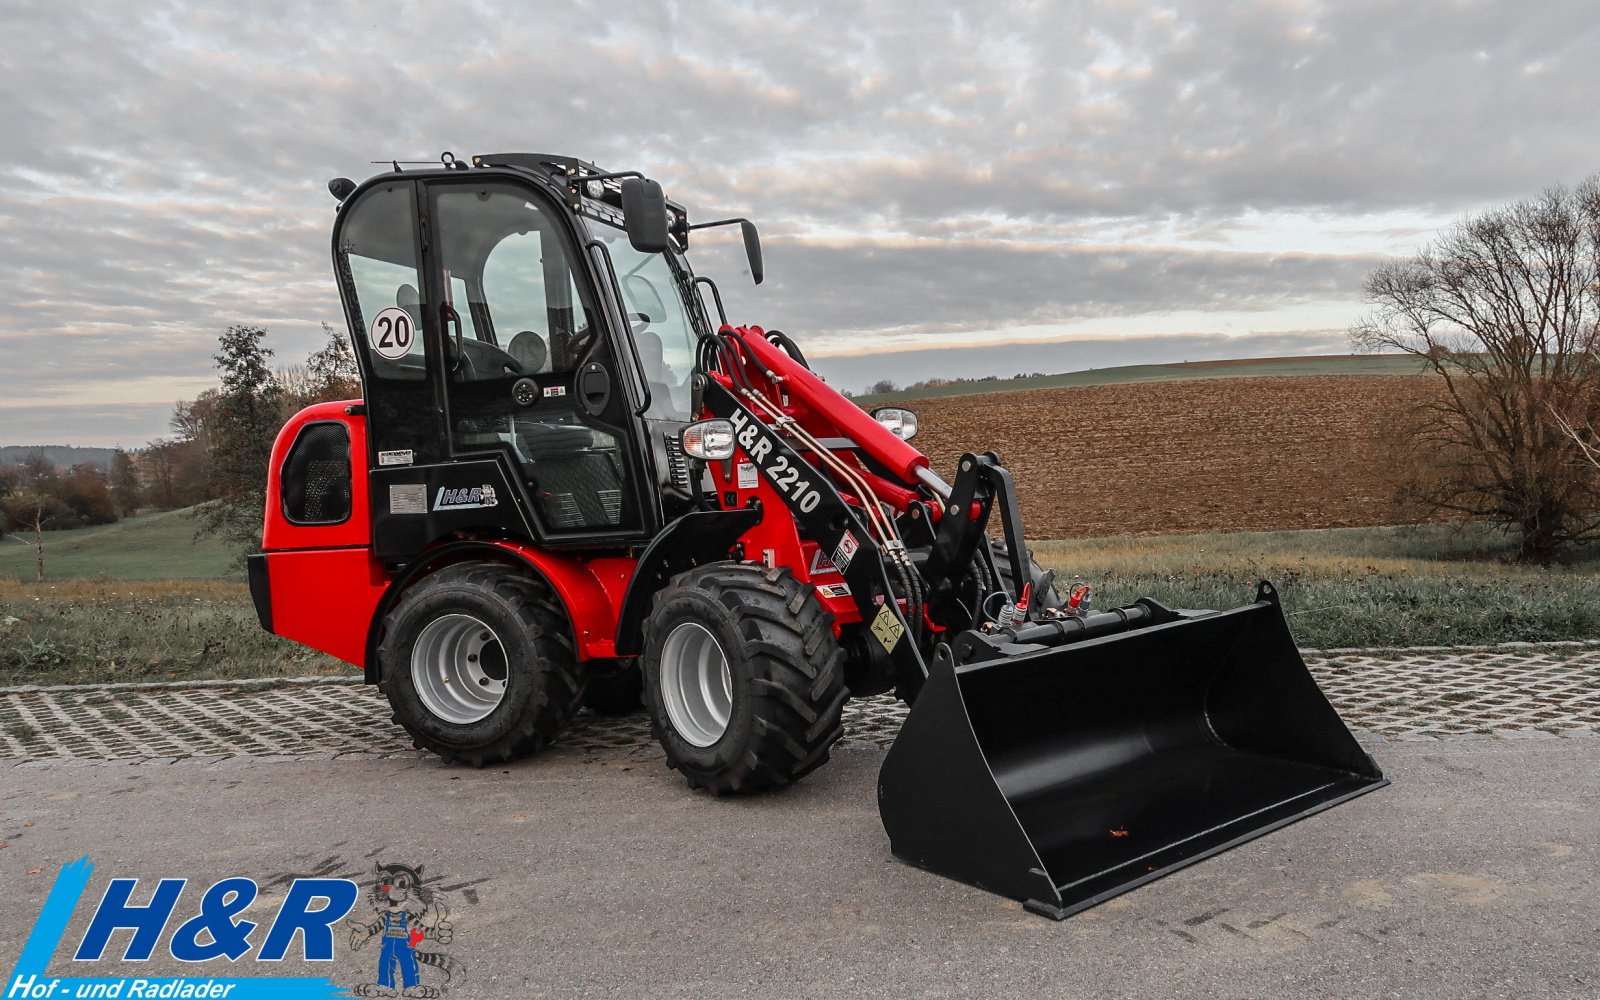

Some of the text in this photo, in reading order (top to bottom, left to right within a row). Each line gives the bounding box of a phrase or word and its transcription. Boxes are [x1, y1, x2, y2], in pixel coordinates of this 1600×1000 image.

[378, 316, 408, 348] 20
[729, 408, 822, 514] H&R 2210
[442, 487, 482, 504] H&R
